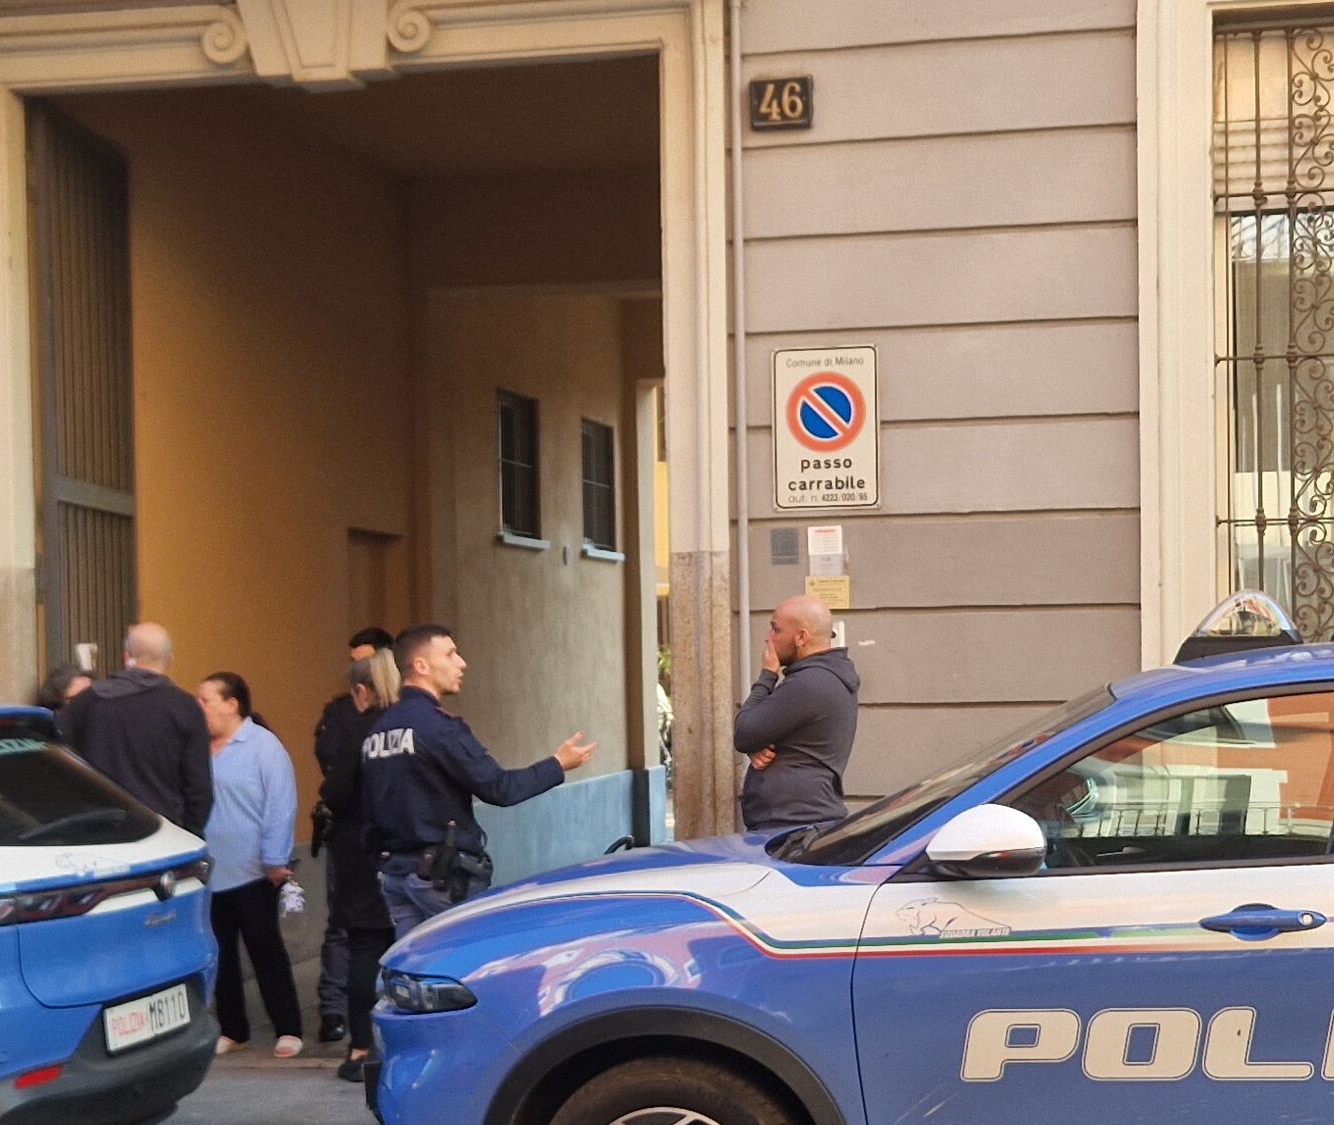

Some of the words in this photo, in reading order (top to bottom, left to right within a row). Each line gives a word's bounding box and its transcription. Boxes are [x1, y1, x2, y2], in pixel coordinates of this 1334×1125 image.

[759, 81, 804, 121] 46
[786, 358, 821, 368] Comune
[824, 357, 832, 366] di
[835, 356, 864, 366] Milano
[800, 458, 852, 473] passo
[788, 475, 866, 491] carrabile
